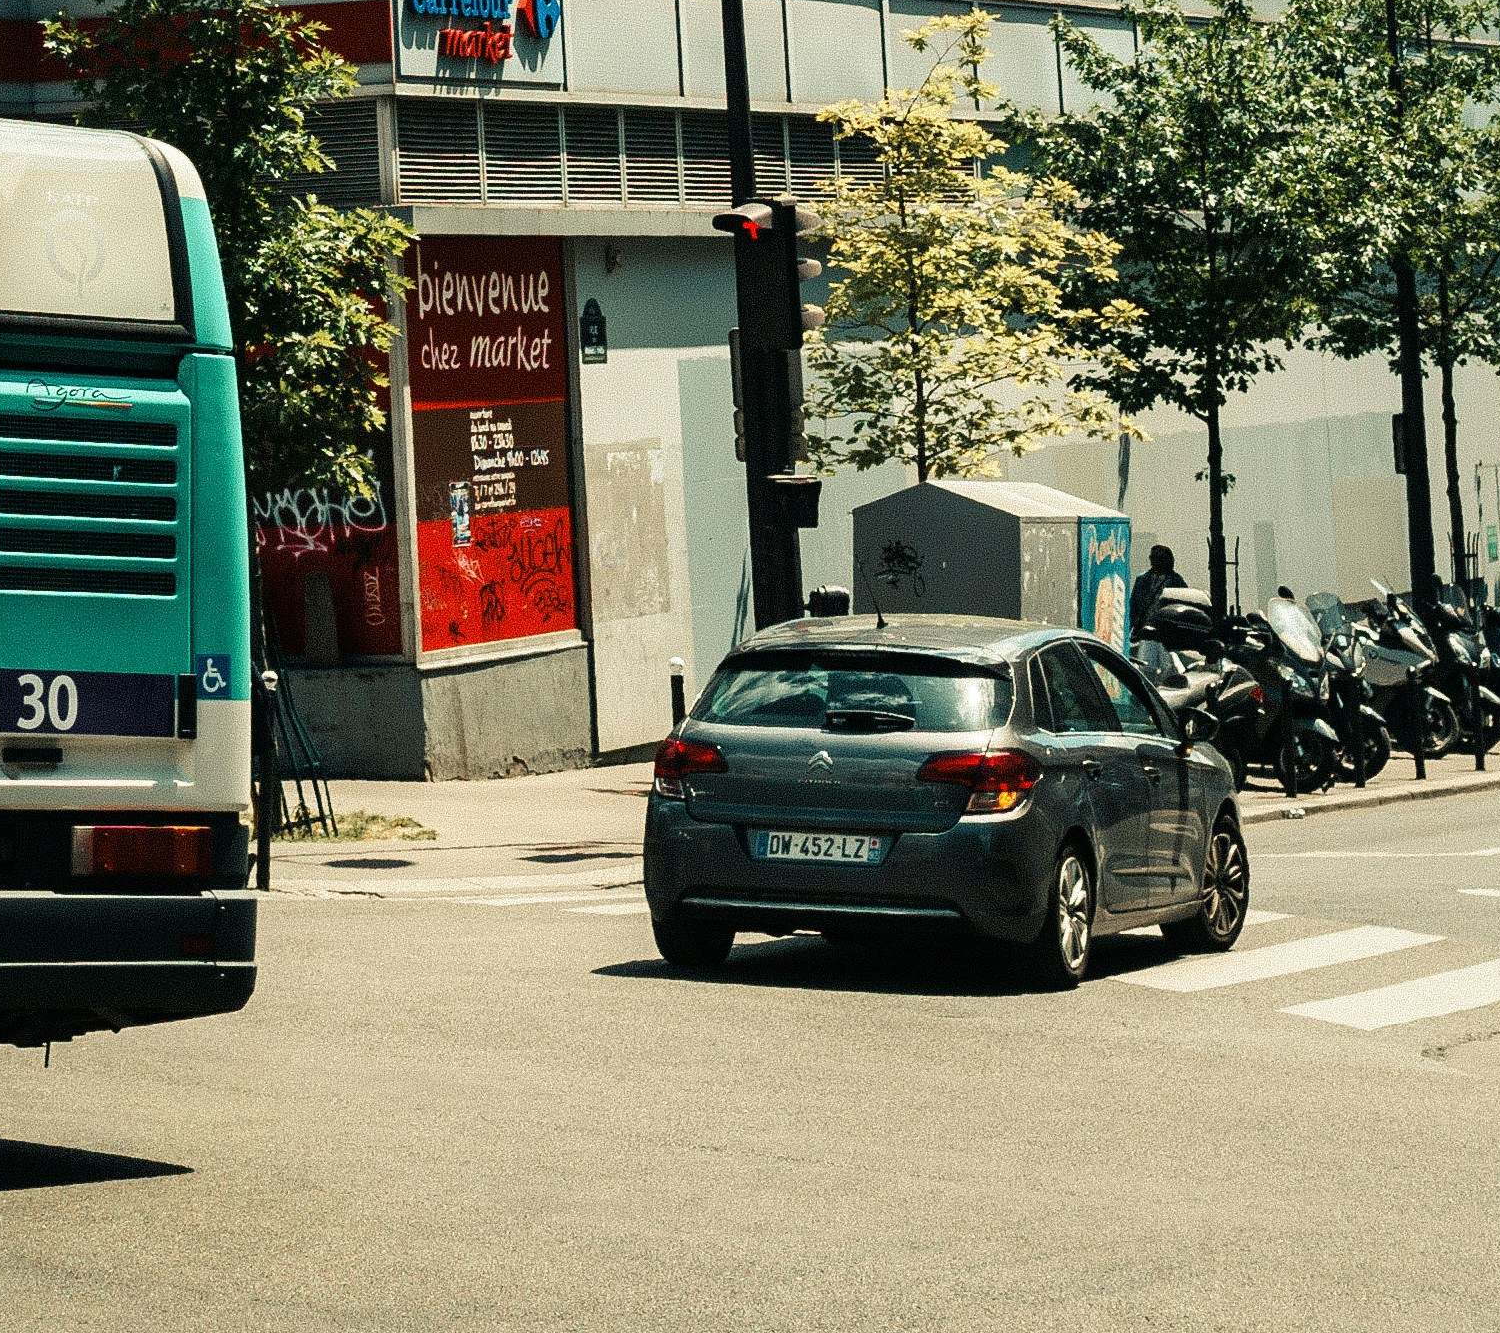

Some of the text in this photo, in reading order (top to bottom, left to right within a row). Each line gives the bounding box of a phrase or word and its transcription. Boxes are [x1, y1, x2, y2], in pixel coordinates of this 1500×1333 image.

[440, 21, 514, 64] market
[416, 243, 550, 320] bienvenue
[421, 326, 552, 372] chez market
[16, 673, 79, 732] 30
[769, 834, 867, 859] DW-452-LZ
